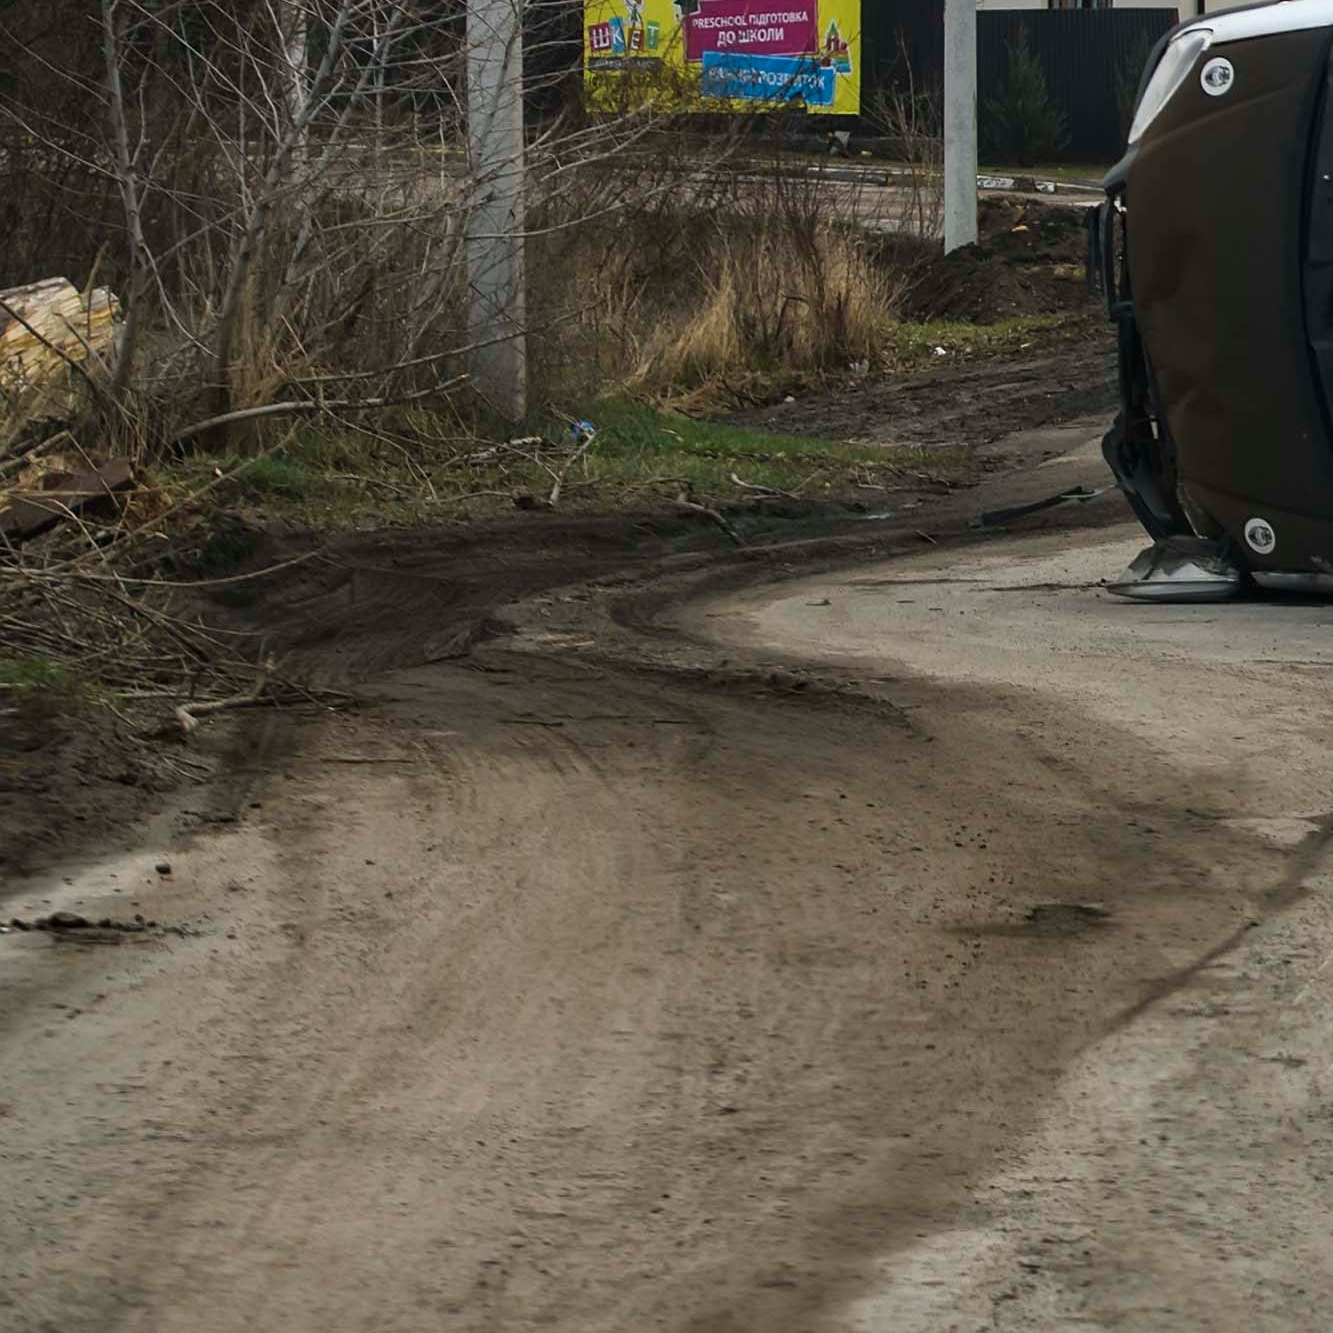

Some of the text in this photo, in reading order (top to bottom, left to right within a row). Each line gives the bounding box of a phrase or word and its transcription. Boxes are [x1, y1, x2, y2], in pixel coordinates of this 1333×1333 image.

[692, 11, 808, 29] PRESCHOOL ПІДГОТОВКА
[593, 25, 659, 50] ШКЕТ
[717, 28, 784, 47] ДО ШКОЛИ
